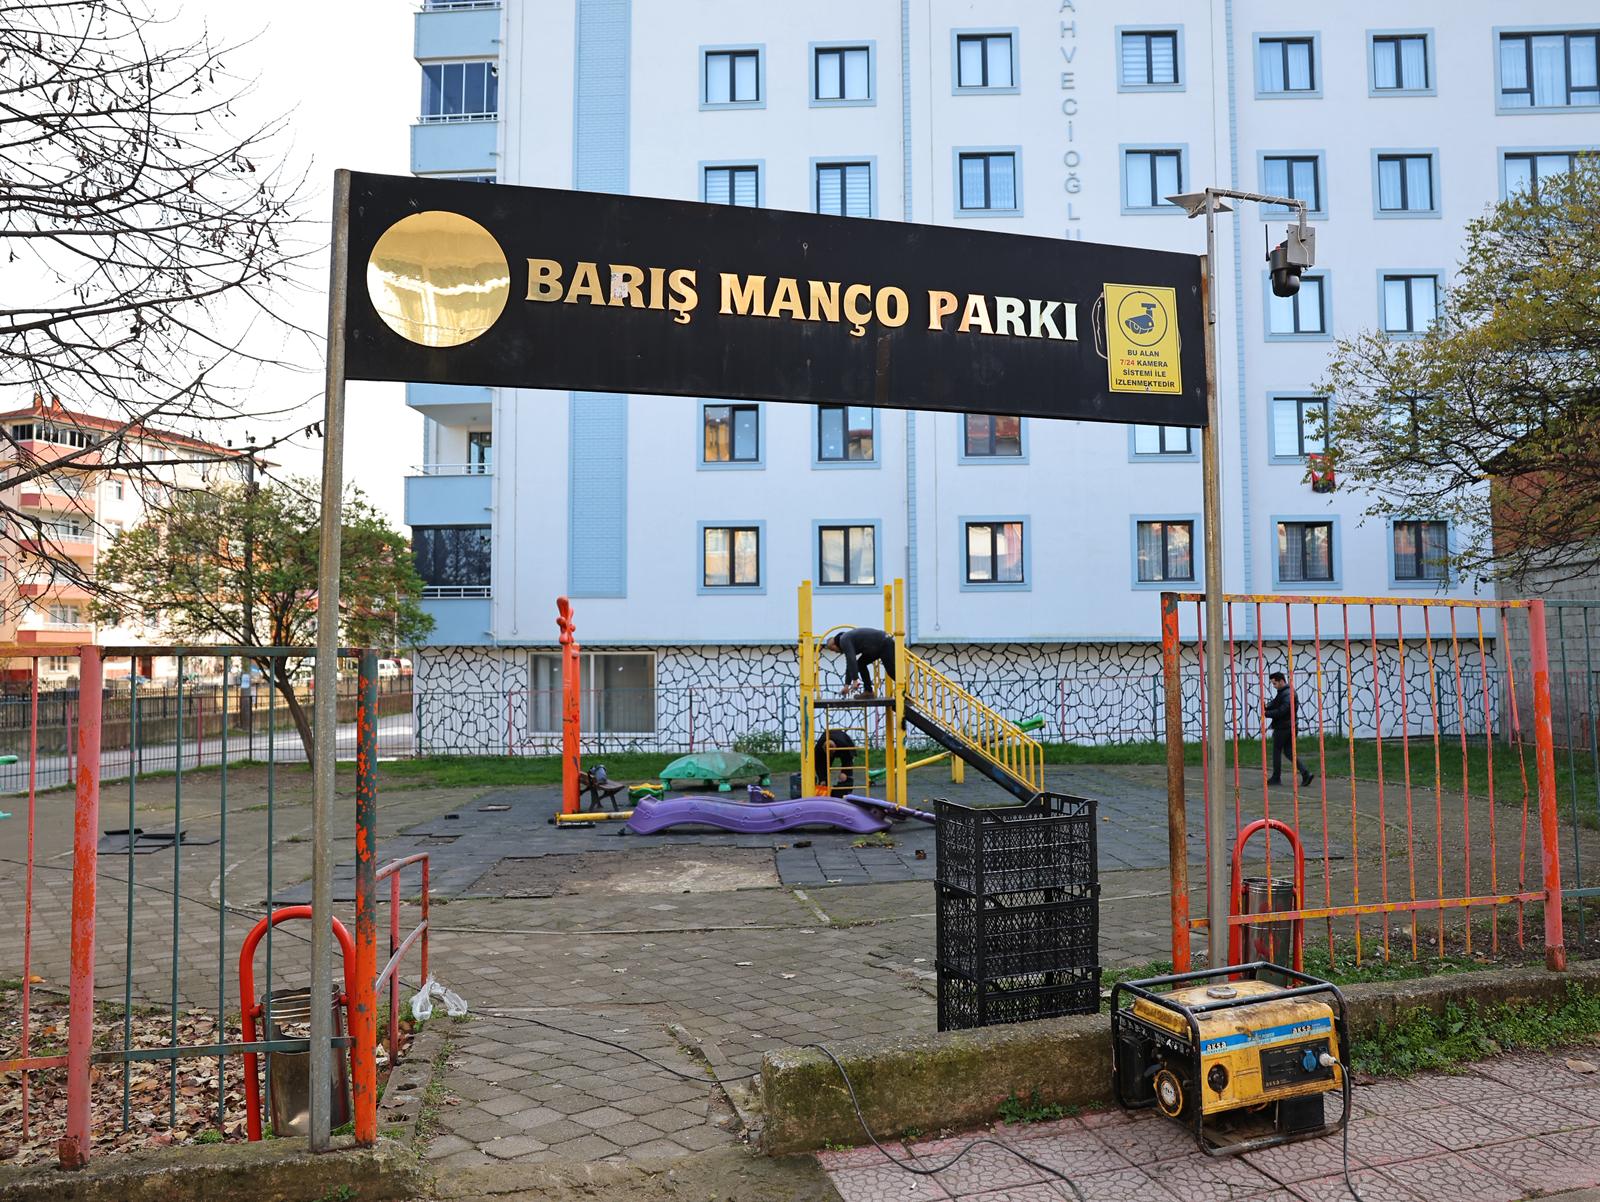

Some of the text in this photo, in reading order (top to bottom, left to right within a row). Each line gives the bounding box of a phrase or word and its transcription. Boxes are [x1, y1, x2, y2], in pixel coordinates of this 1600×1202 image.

[525, 258, 1078, 341] BARIŞ MANÇO PARKI
[1136, 359, 1169, 368] KAMERA
[1154, 370, 1167, 378] İLE
[1115, 378, 1175, 388] İZLENMEKTEDİR
